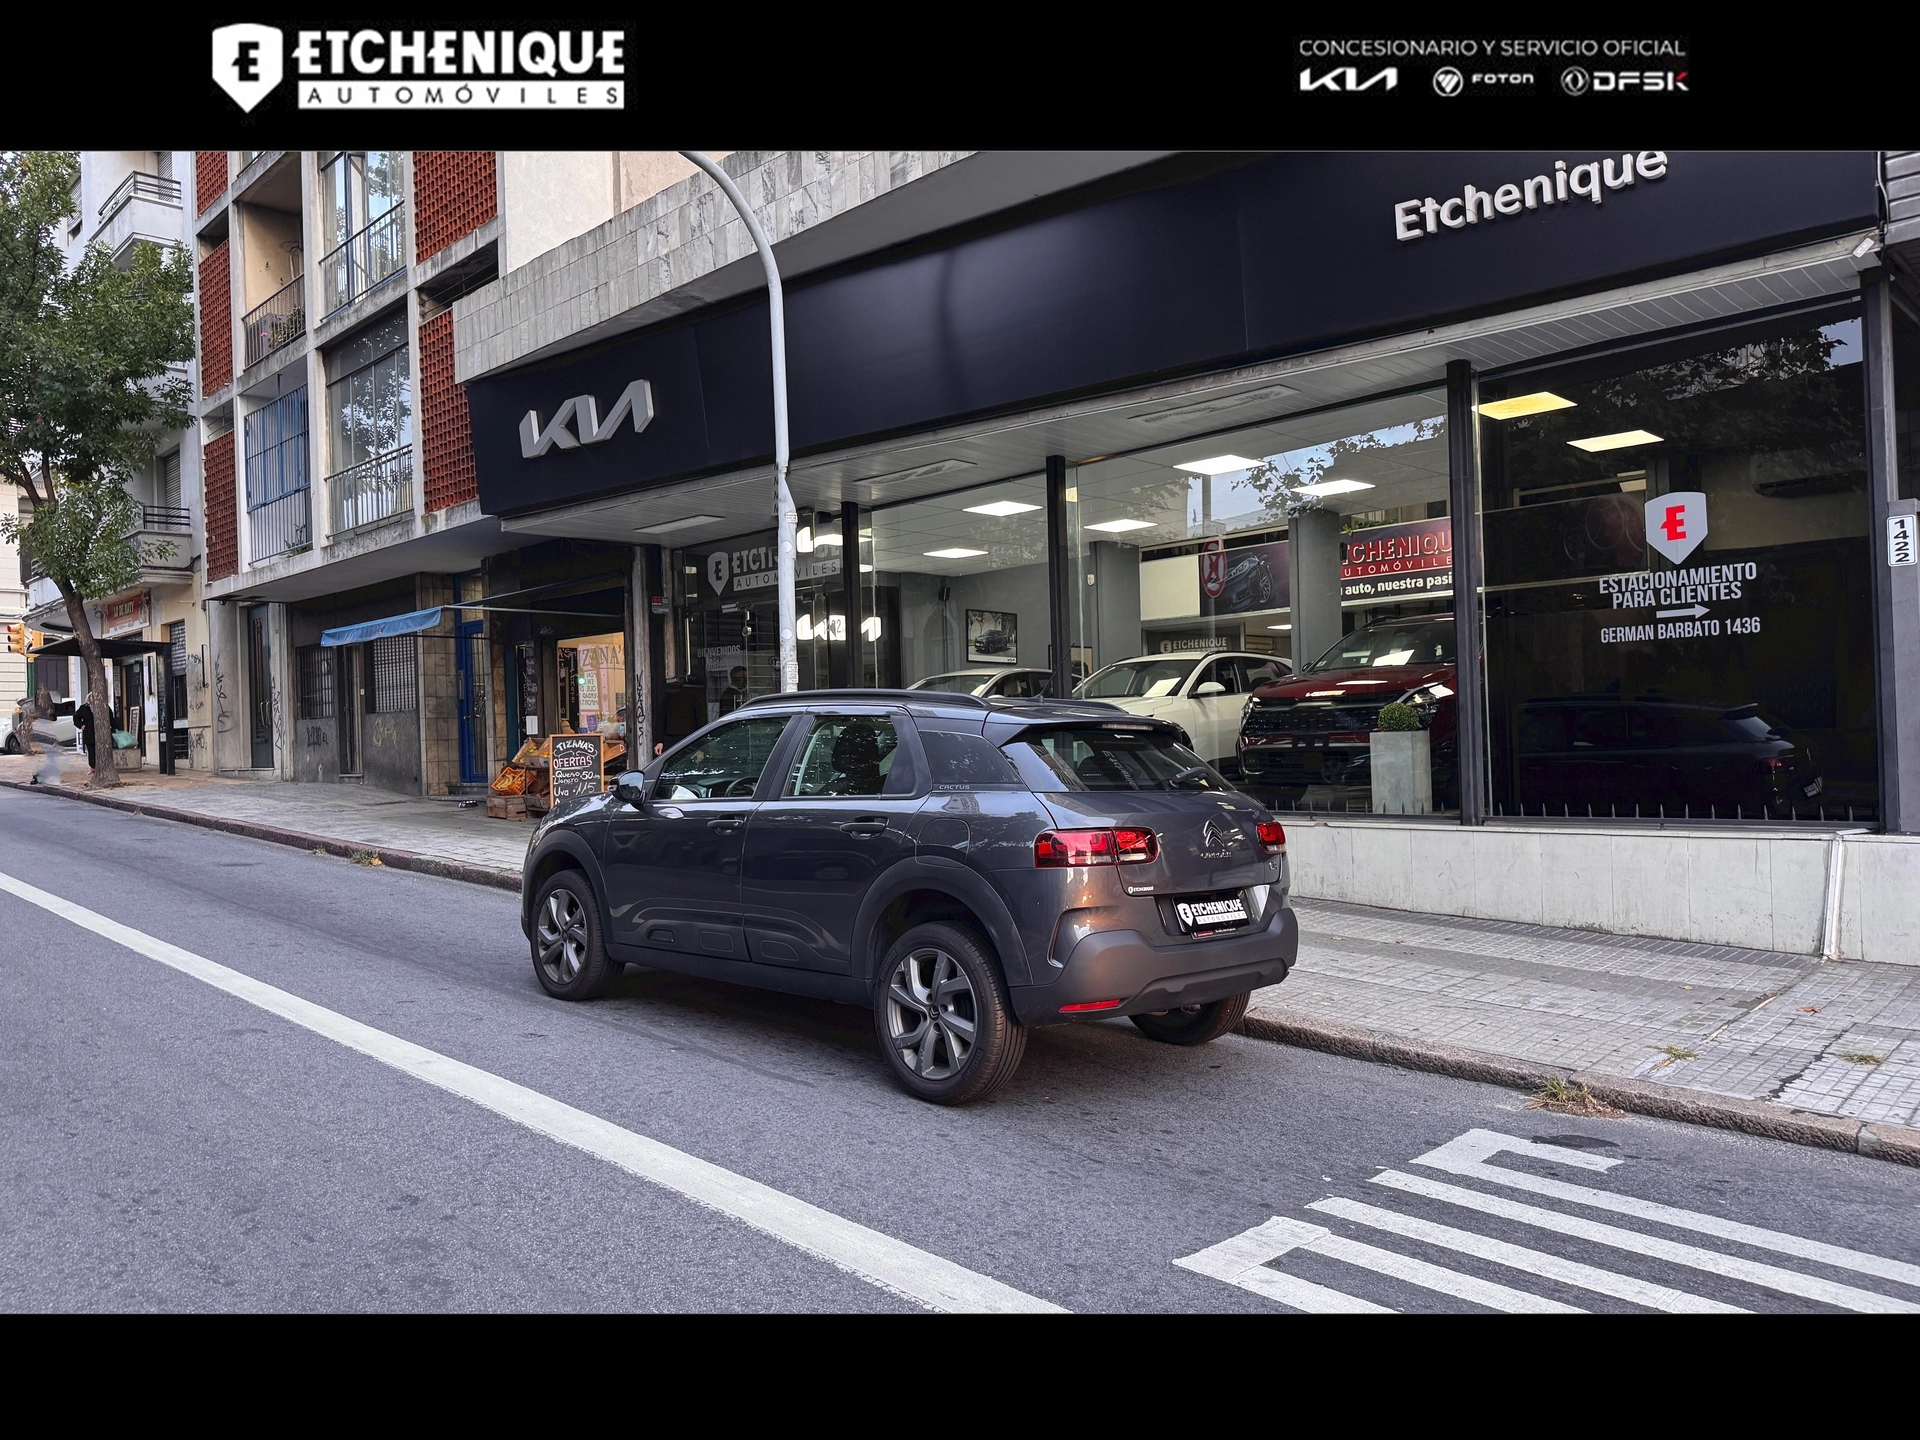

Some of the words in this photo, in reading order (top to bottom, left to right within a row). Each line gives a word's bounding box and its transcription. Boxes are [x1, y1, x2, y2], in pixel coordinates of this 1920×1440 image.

[1394, 151, 1668, 241] Etchenique
[519, 379, 654, 458] KIA
[1893, 519, 1910, 563] 1422
[1345, 583, 1375, 595] auto,
[1377, 576, 1424, 592] nuestra
[1599, 562, 1757, 594] ESTACIONAMIENTO
[1612, 590, 1656, 609] PARA
[1660, 581, 1742, 606] CLIENTES
[1173, 637, 1226, 650] ETCHENIQUE
[1600, 624, 1654, 644] GERMAN
[1657, 619, 1720, 640] BARBATO
[1724, 616, 1761, 635] 1436
[697, 645, 741, 658] BIENVENIDOS
[553, 756, 593, 769] OFERTAS
[1190, 899, 1244, 916] ETCHENIQUE
